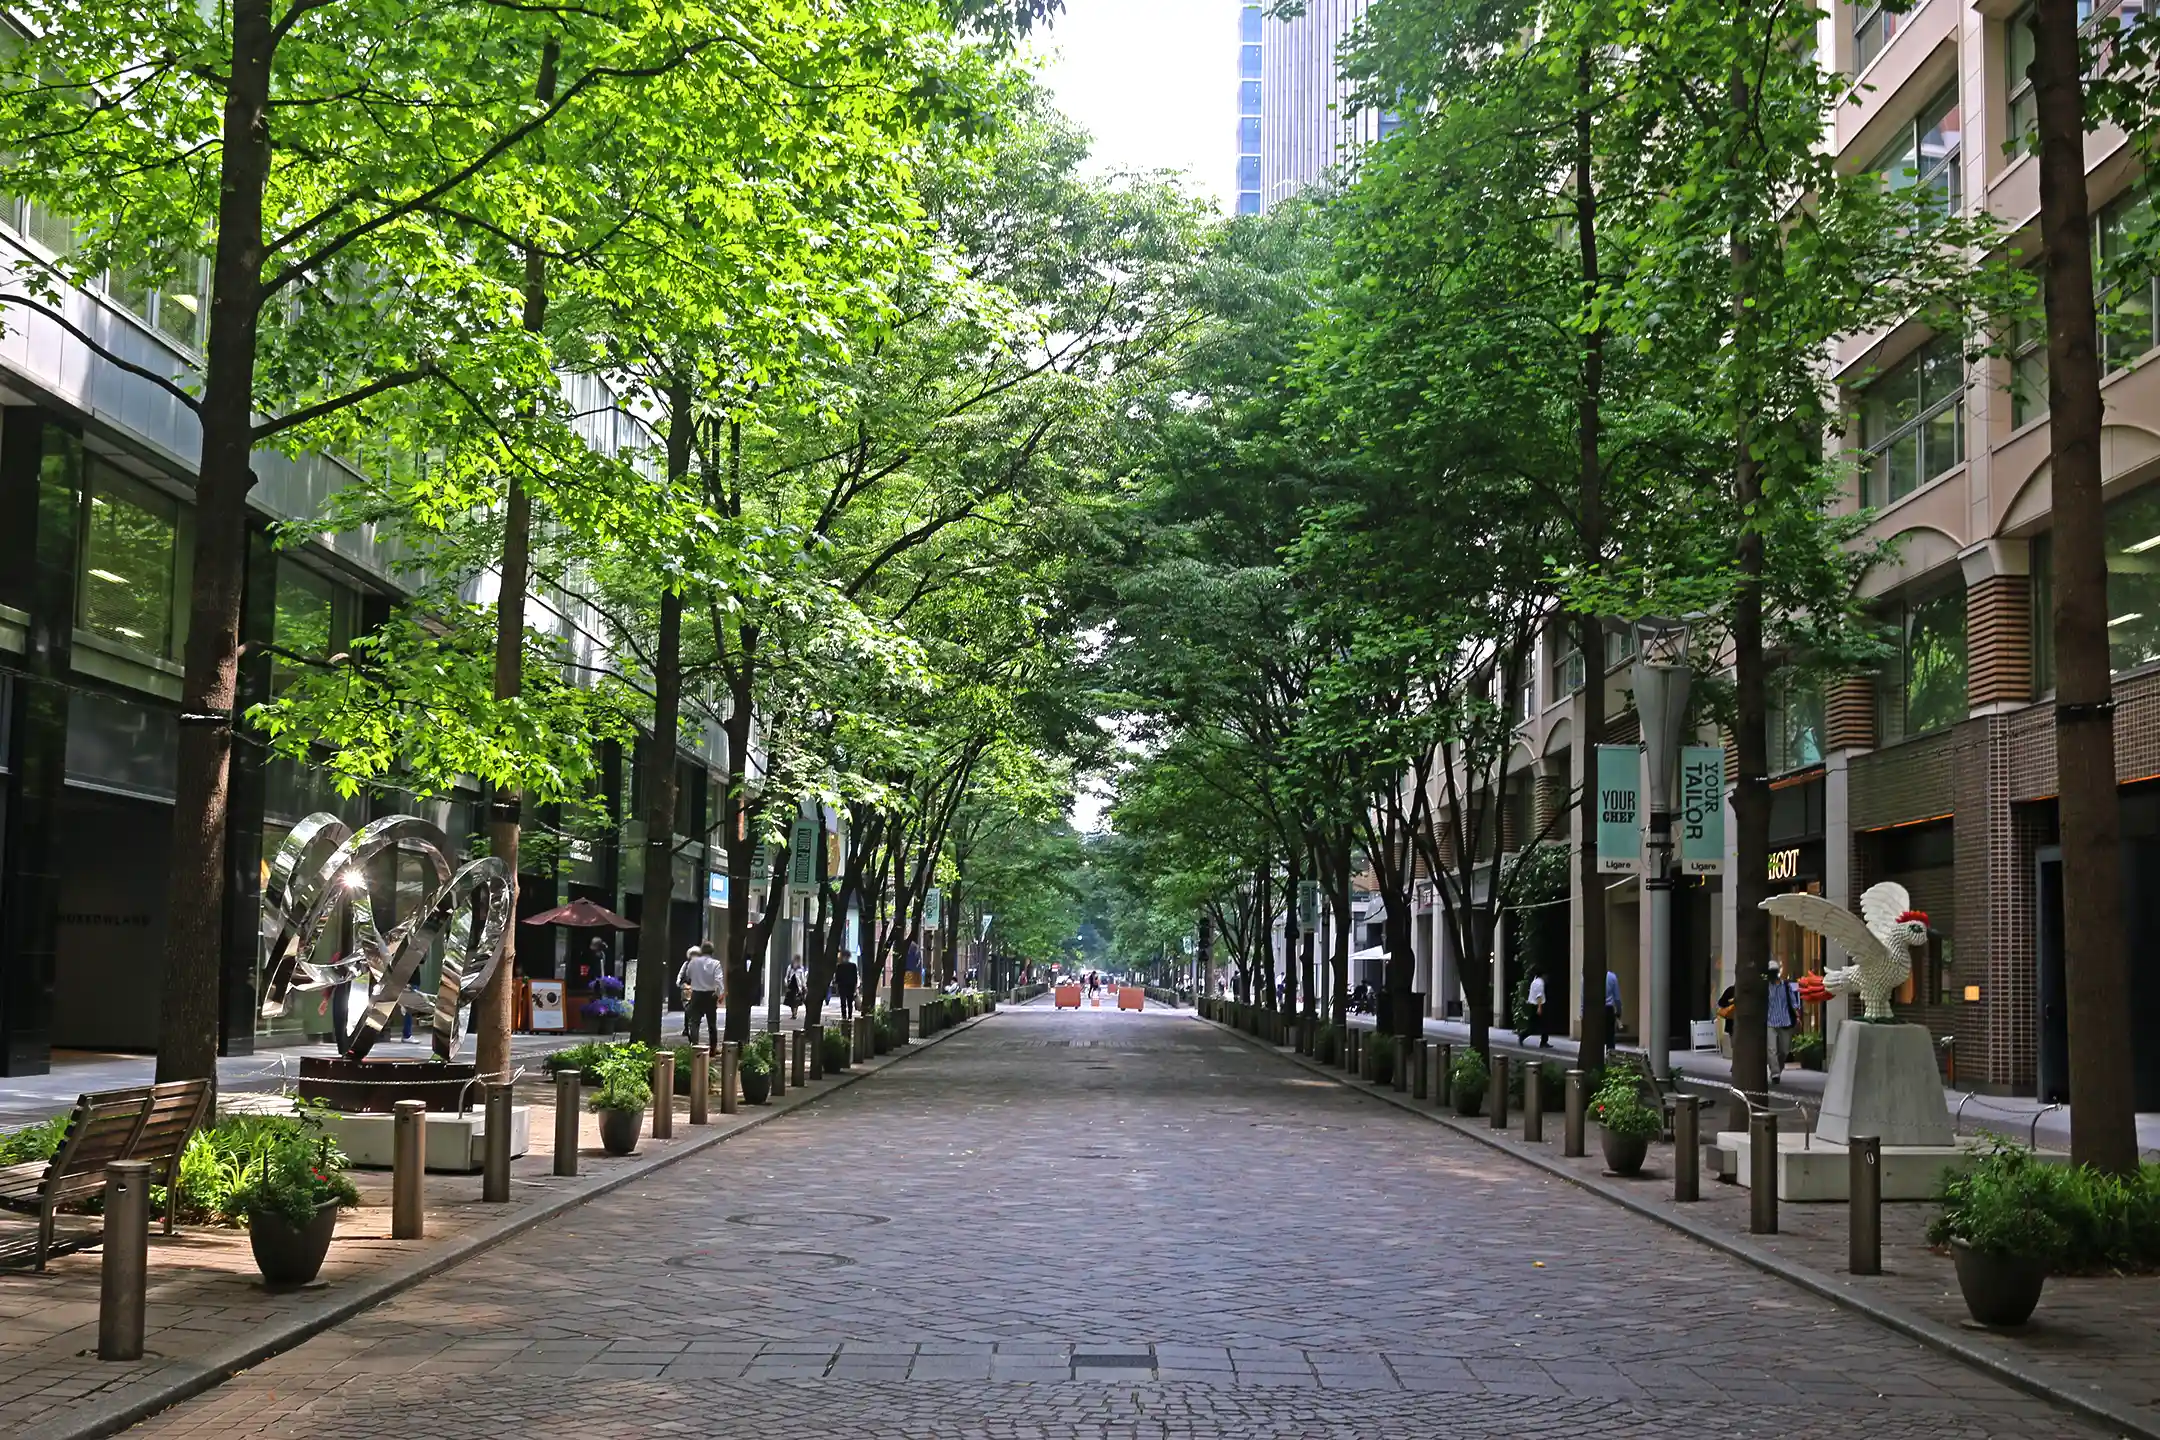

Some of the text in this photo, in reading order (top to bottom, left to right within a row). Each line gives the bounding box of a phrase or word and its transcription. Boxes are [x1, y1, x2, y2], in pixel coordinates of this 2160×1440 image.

[1704, 761, 1719, 813] YOUR
[1602, 790, 1636, 810] YOUR
[1686, 762, 1703, 840] TAILOR
[1602, 811, 1635, 823] CHEF
[1605, 860, 1631, 869] Ligare
[1691, 861, 1717, 871] Ligare
